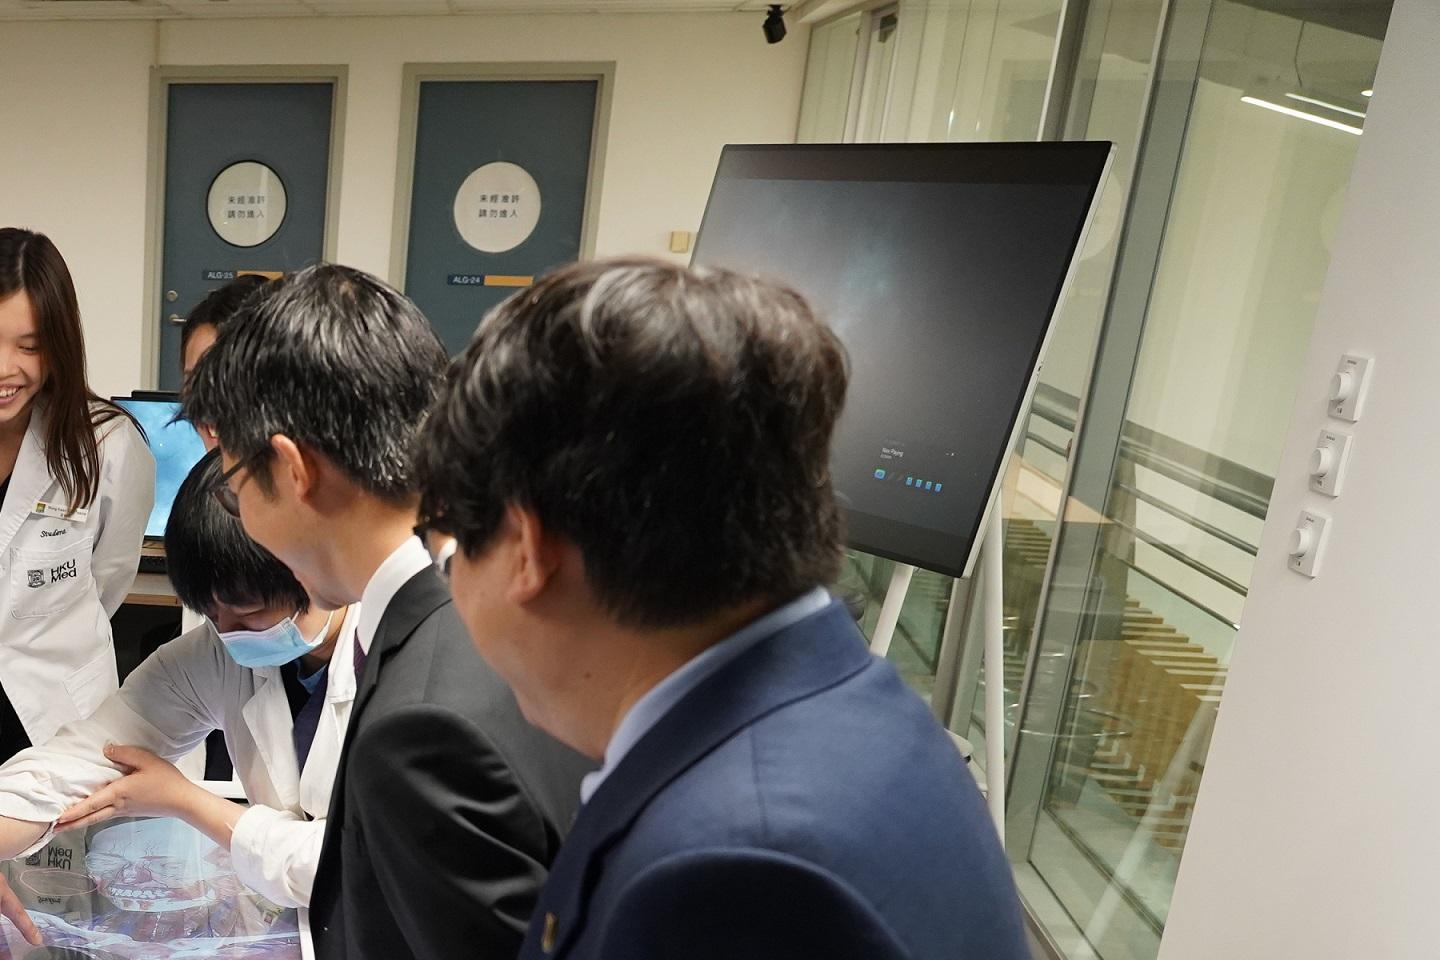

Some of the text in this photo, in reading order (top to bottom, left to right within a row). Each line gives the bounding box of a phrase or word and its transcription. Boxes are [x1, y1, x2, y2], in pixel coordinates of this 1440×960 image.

[452, 275, 481, 284] ALG-24
[50, 559, 76, 575] HKU
[50, 567, 77, 584] Med
